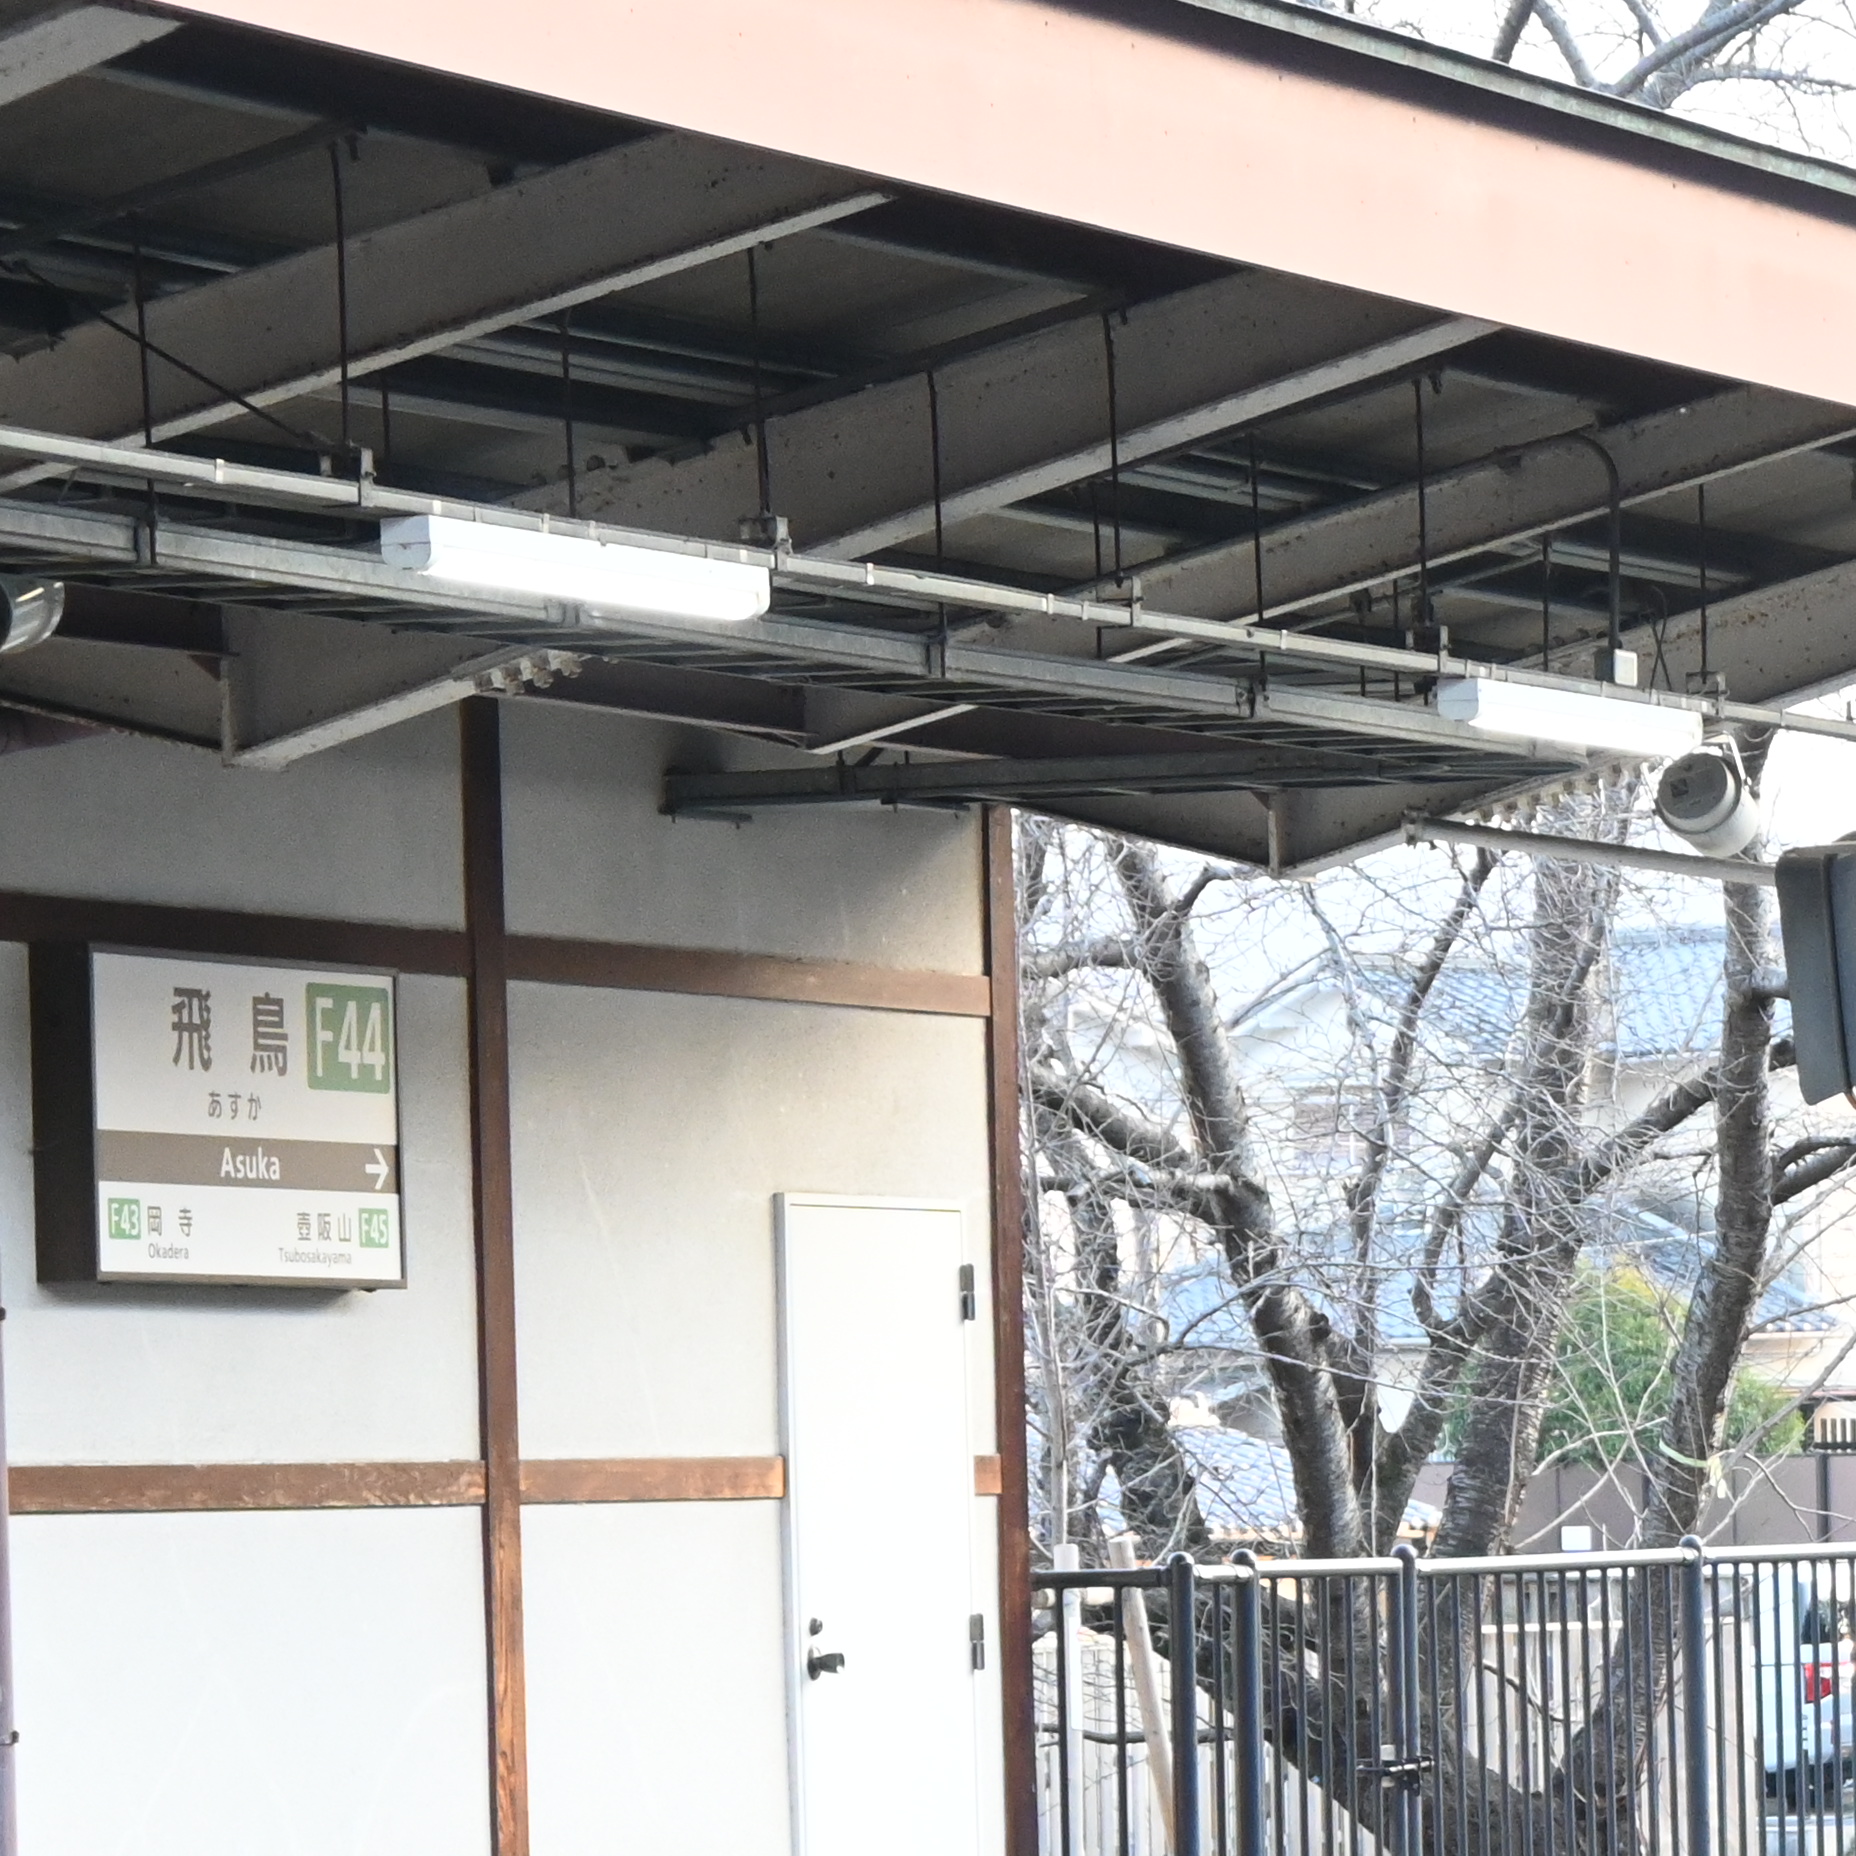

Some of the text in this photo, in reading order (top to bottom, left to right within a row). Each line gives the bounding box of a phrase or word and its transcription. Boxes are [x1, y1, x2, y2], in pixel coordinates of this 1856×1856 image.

[171, 986, 289, 1077] 飛鳥
[315, 997, 386, 1081] F44
[207, 1090, 263, 1122] あすか
[220, 1146, 281, 1181] Asuka
[110, 1202, 139, 1237] F43
[147, 1205, 193, 1238] 岡寺
[361, 1211, 388, 1246] F45
[148, 1242, 190, 1260] Okadera
[278, 1246, 352, 1268] Tsubosakayama
